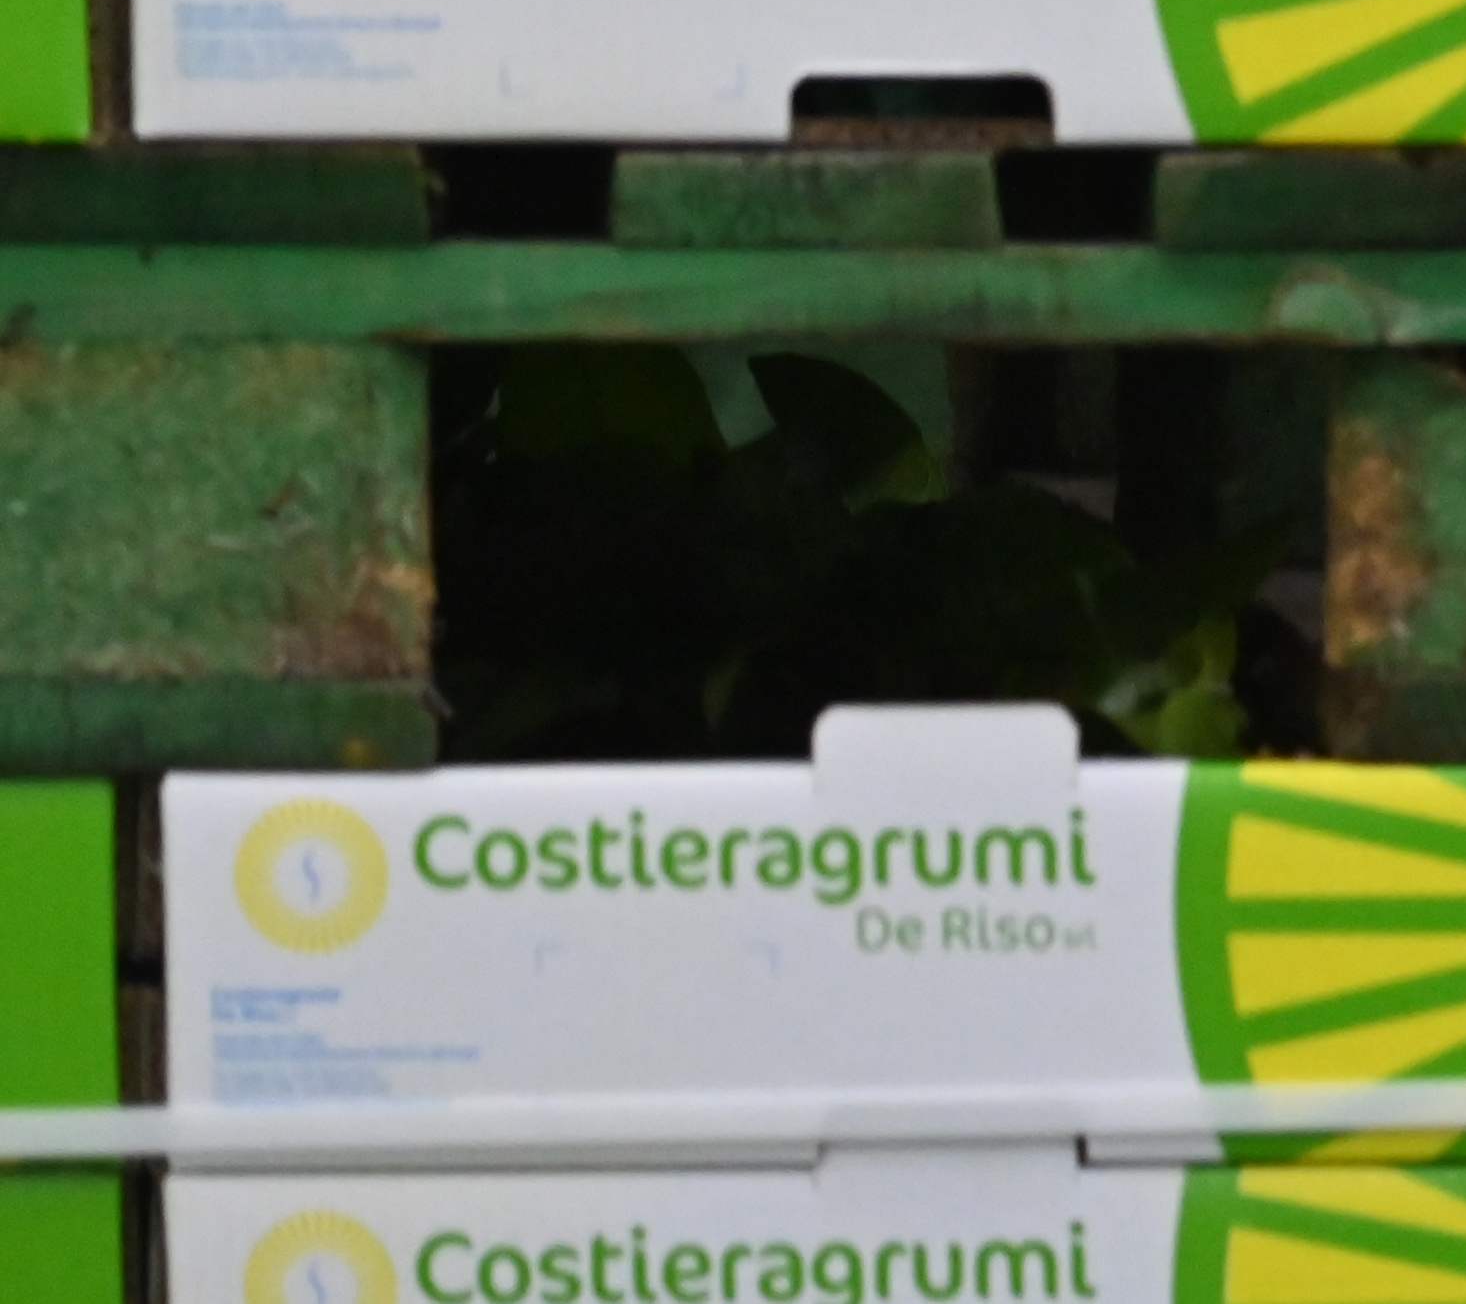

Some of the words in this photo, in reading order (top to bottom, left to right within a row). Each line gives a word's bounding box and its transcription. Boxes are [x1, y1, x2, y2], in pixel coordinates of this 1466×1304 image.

[414, 810, 1098, 906] Costieragrumi
[855, 905, 926, 954] De
[942, 901, 1058, 953] Riso
